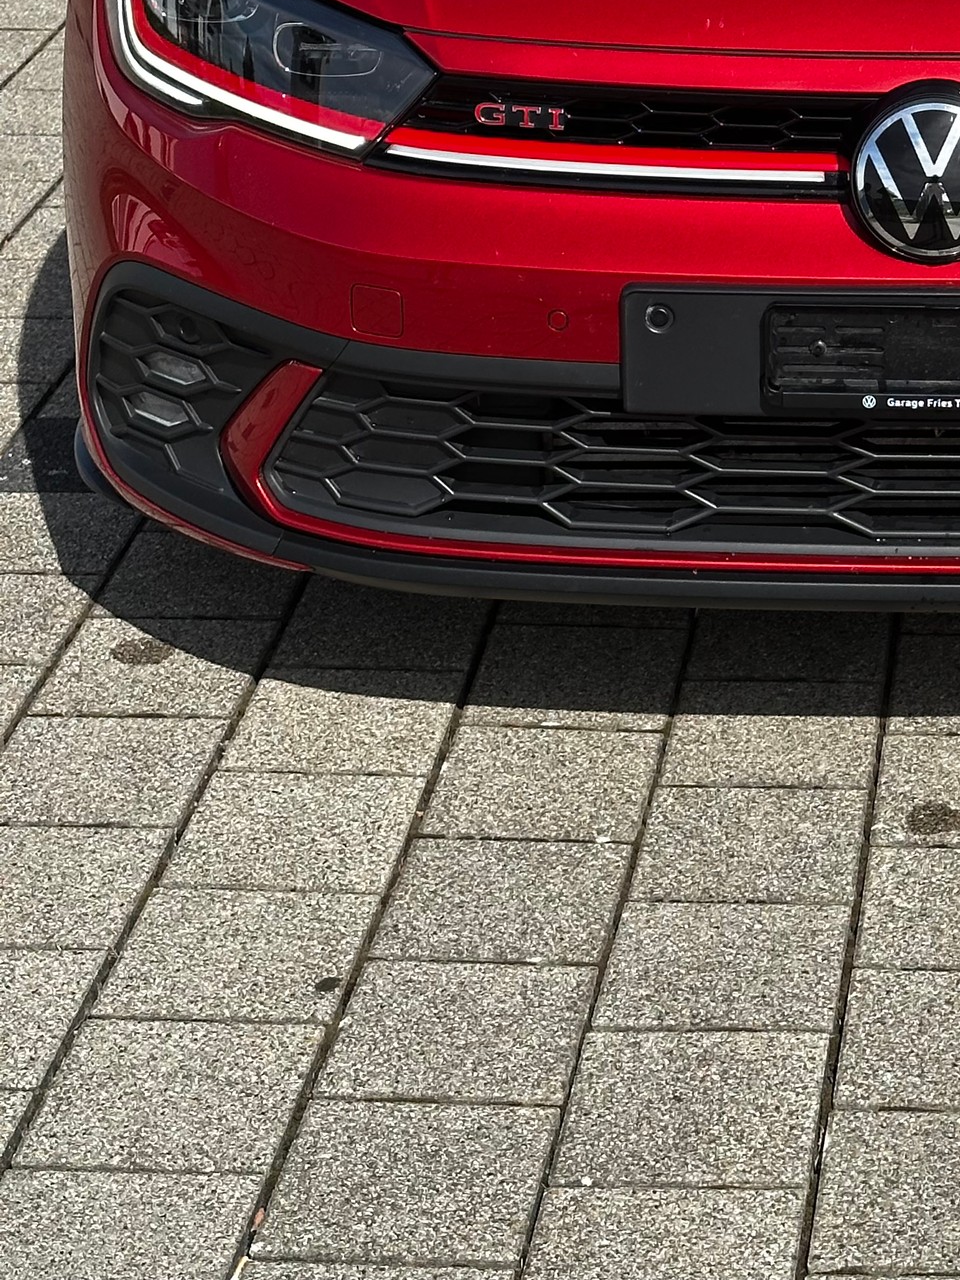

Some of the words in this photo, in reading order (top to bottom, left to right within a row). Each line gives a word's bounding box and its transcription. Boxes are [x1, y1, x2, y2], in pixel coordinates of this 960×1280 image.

[474, 102, 565, 131] GTI
[887, 398, 925, 409] Garage
[927, 398, 953, 408] Fries
